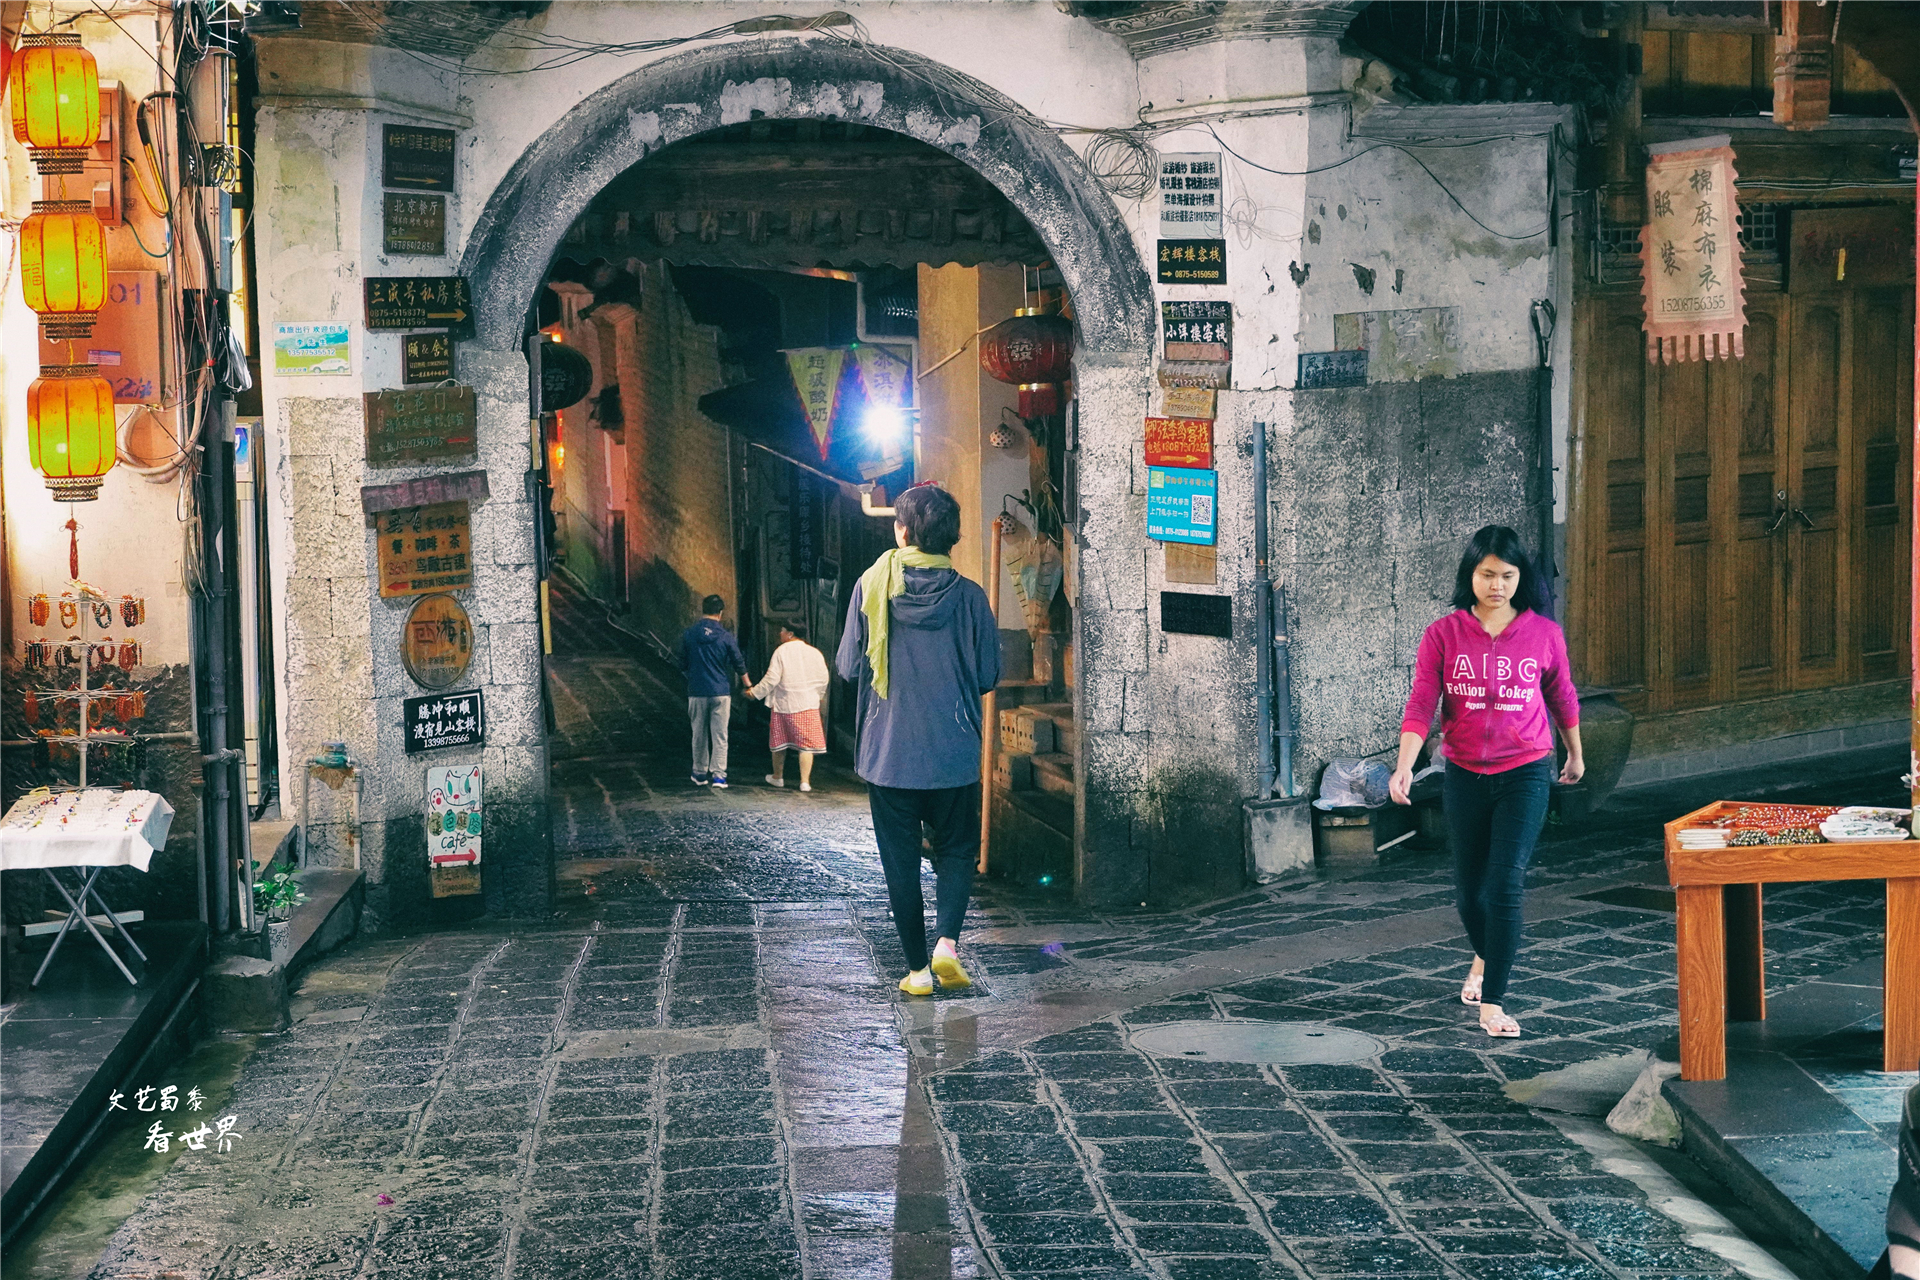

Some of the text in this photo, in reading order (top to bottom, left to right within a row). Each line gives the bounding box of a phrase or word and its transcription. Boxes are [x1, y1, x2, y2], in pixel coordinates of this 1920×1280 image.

[394, 198, 438, 216] 北京餐厅
[1688, 168, 1722, 292] 棉麻布衣
[1653, 189, 1681, 277] 服装
[1660, 294, 1726, 313] 15208756355
[807, 354, 828, 422] 超级酸奶
[873, 353, 894, 404] 冰淇
[423, 733, 470, 748] 13398755666
